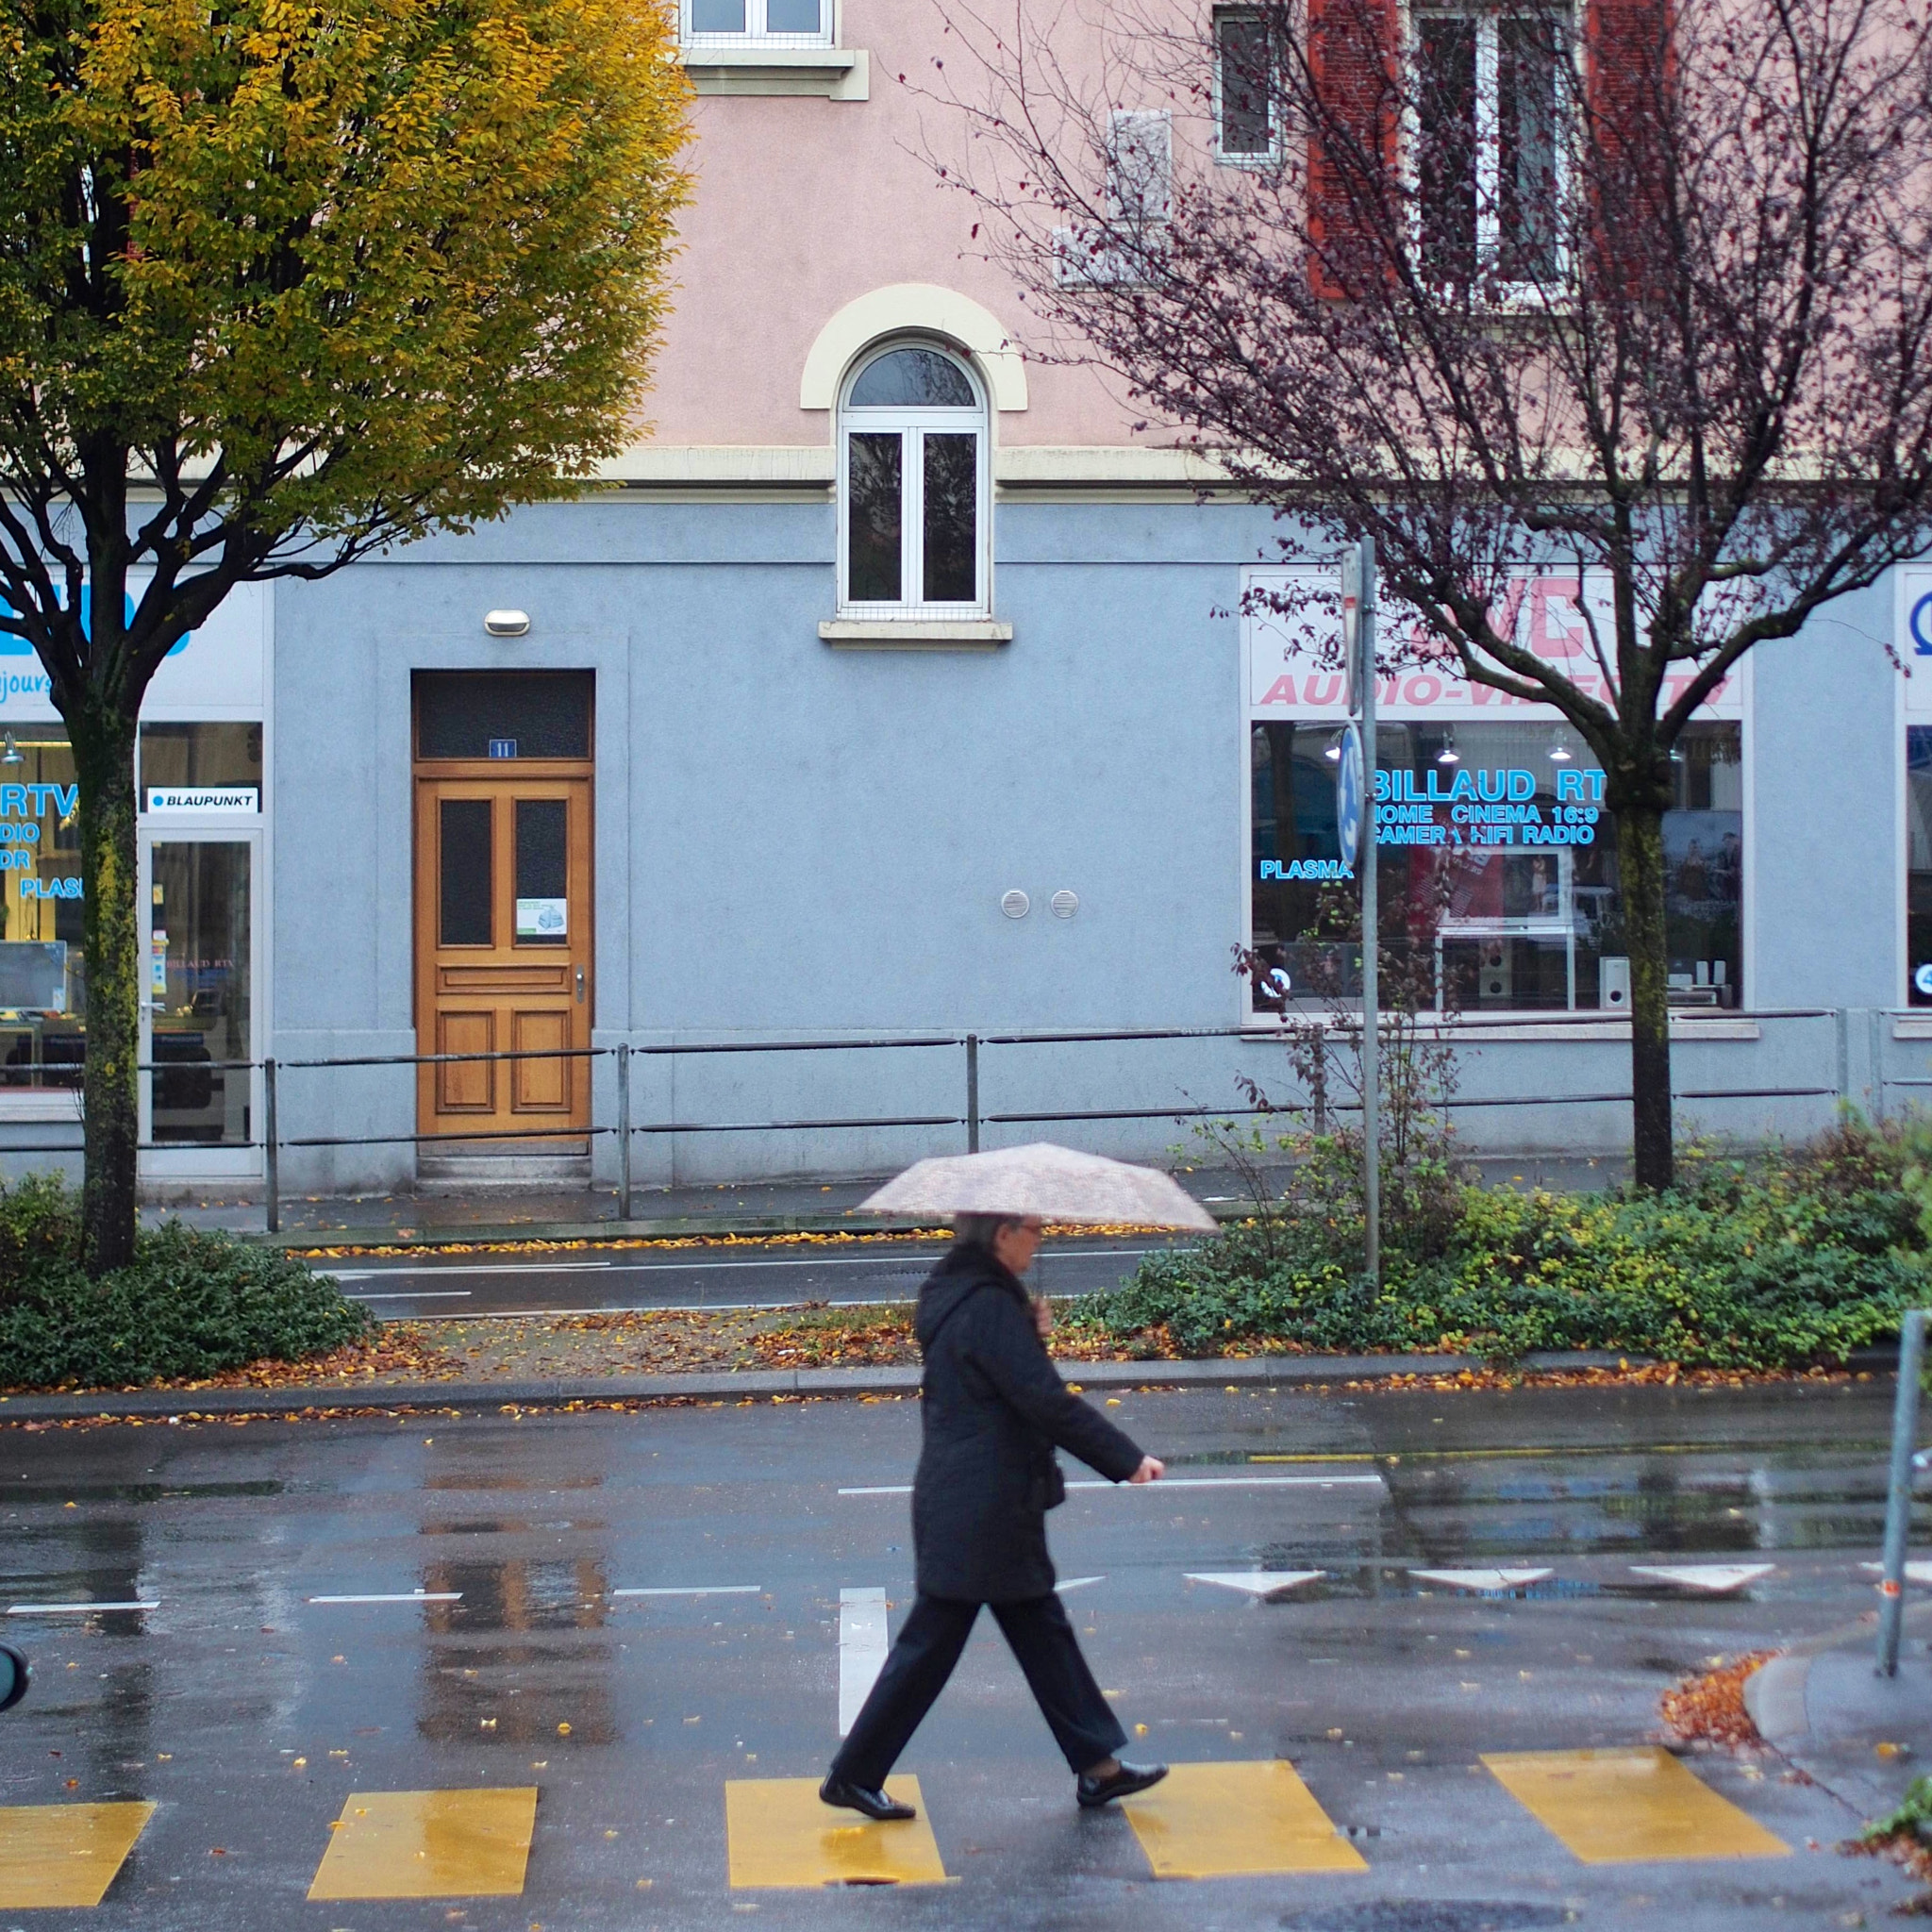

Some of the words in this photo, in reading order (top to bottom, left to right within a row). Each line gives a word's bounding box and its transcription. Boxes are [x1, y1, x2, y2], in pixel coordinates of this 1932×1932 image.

[0, 671, 51, 704] jours
[497, 741, 508, 758] 11
[1374, 769, 1536, 802] BILLAUD
[0, 783, 79, 817] RTV
[167, 795, 253, 807] BLAUPUNKT
[1451, 805, 1541, 824] CINEMA
[1552, 806, 1599, 824] 16:9
[1471, 825, 1513, 844] HIFI
[1523, 825, 1594, 844] RADIO
[1260, 859, 1355, 879] PLASMA
[21, 877, 83, 899] PLAS
